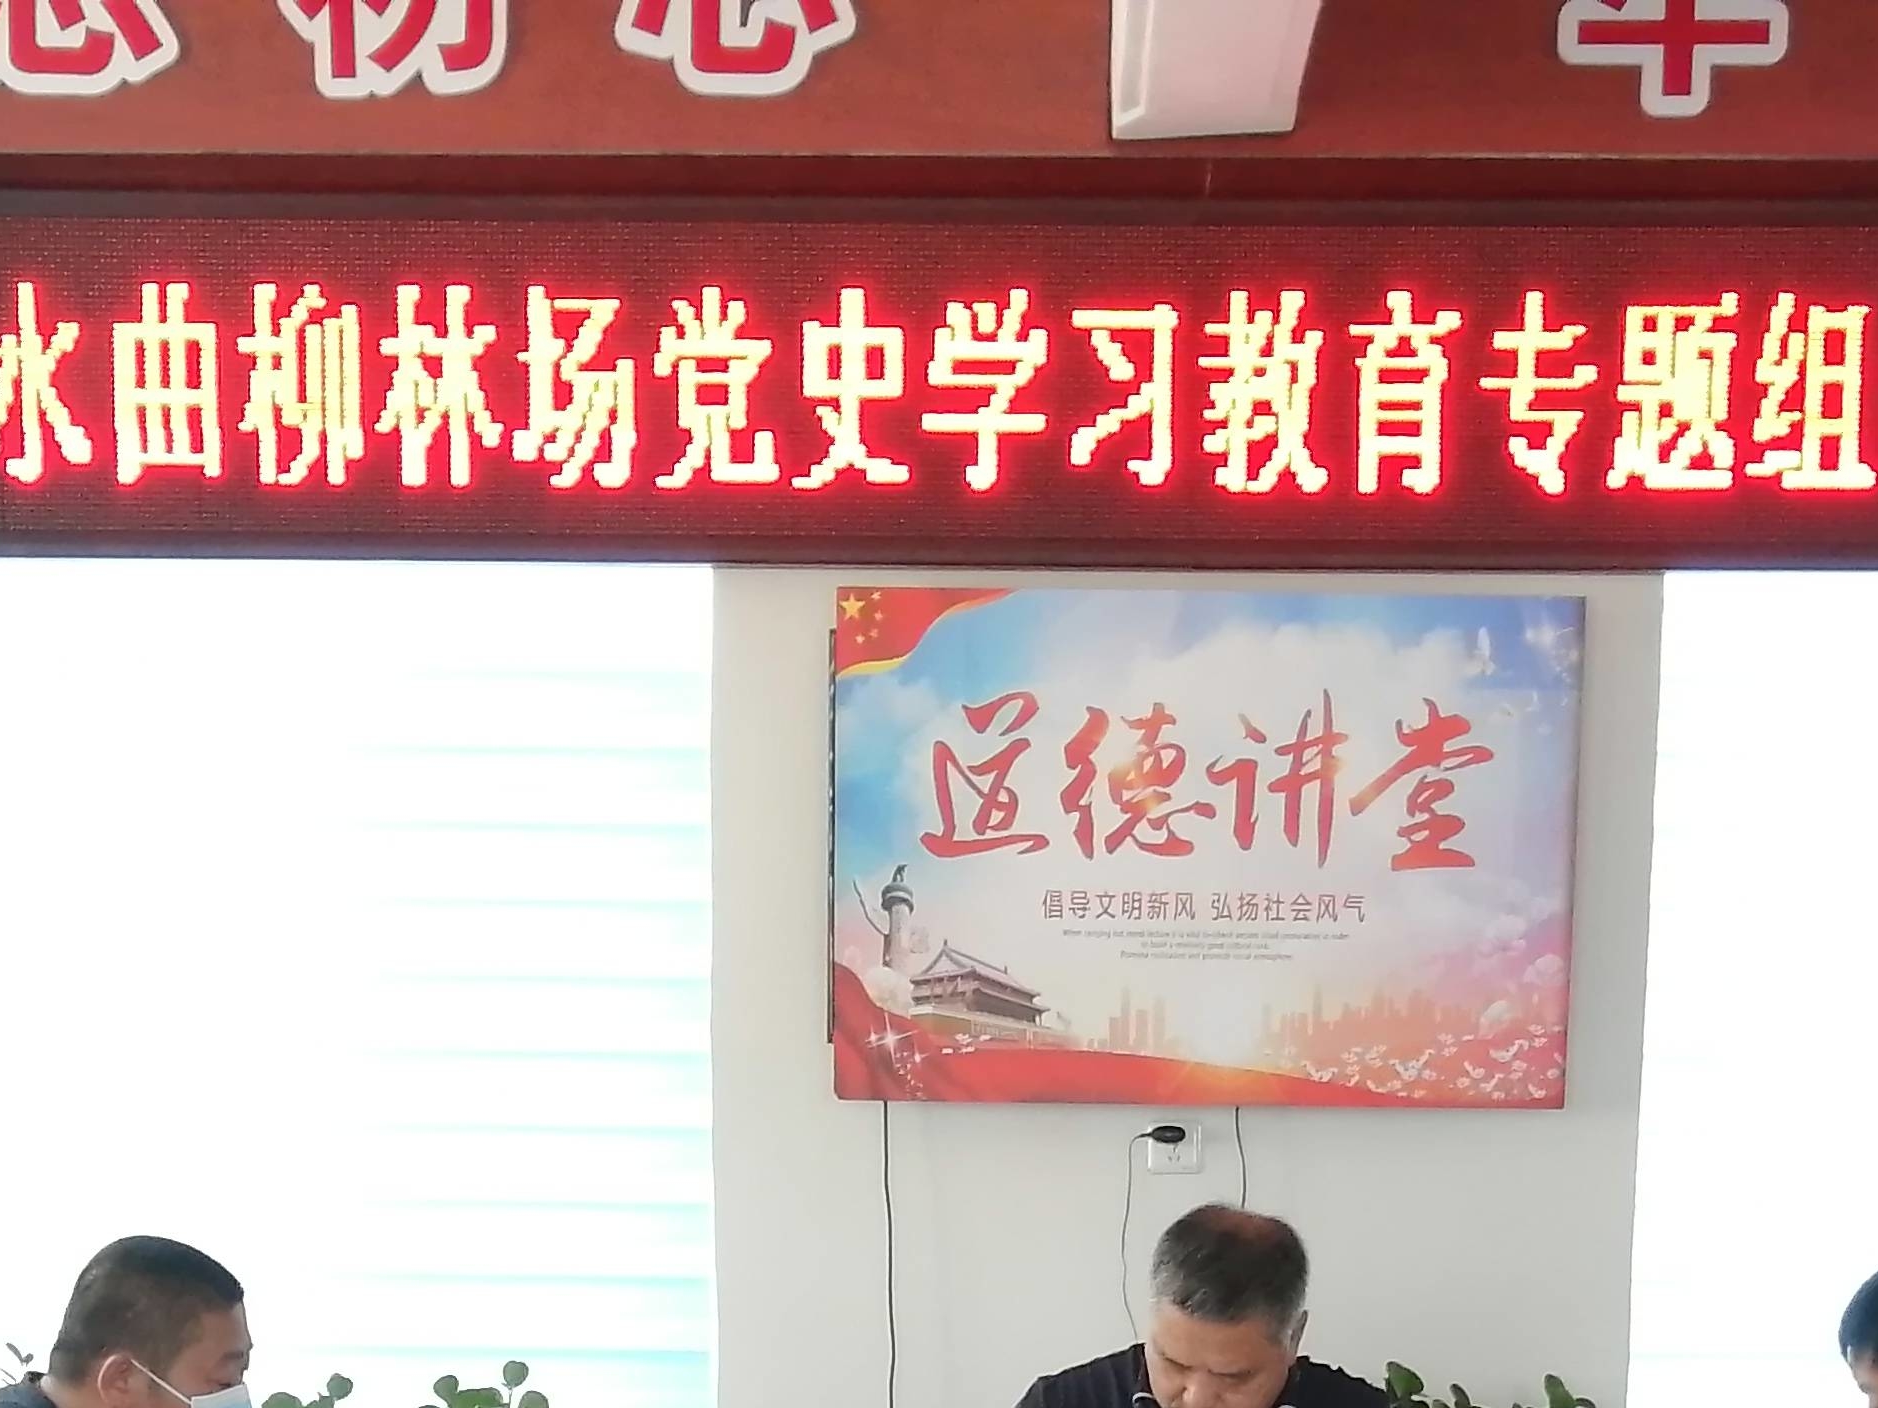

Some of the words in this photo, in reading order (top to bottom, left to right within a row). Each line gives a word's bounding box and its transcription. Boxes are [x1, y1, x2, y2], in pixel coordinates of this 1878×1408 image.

[919, 689, 1495, 872] 道德讲堂
[1042, 889, 1196, 921] 倡导文明新风
[1210, 892, 1367, 924] 弘扬社会风气
